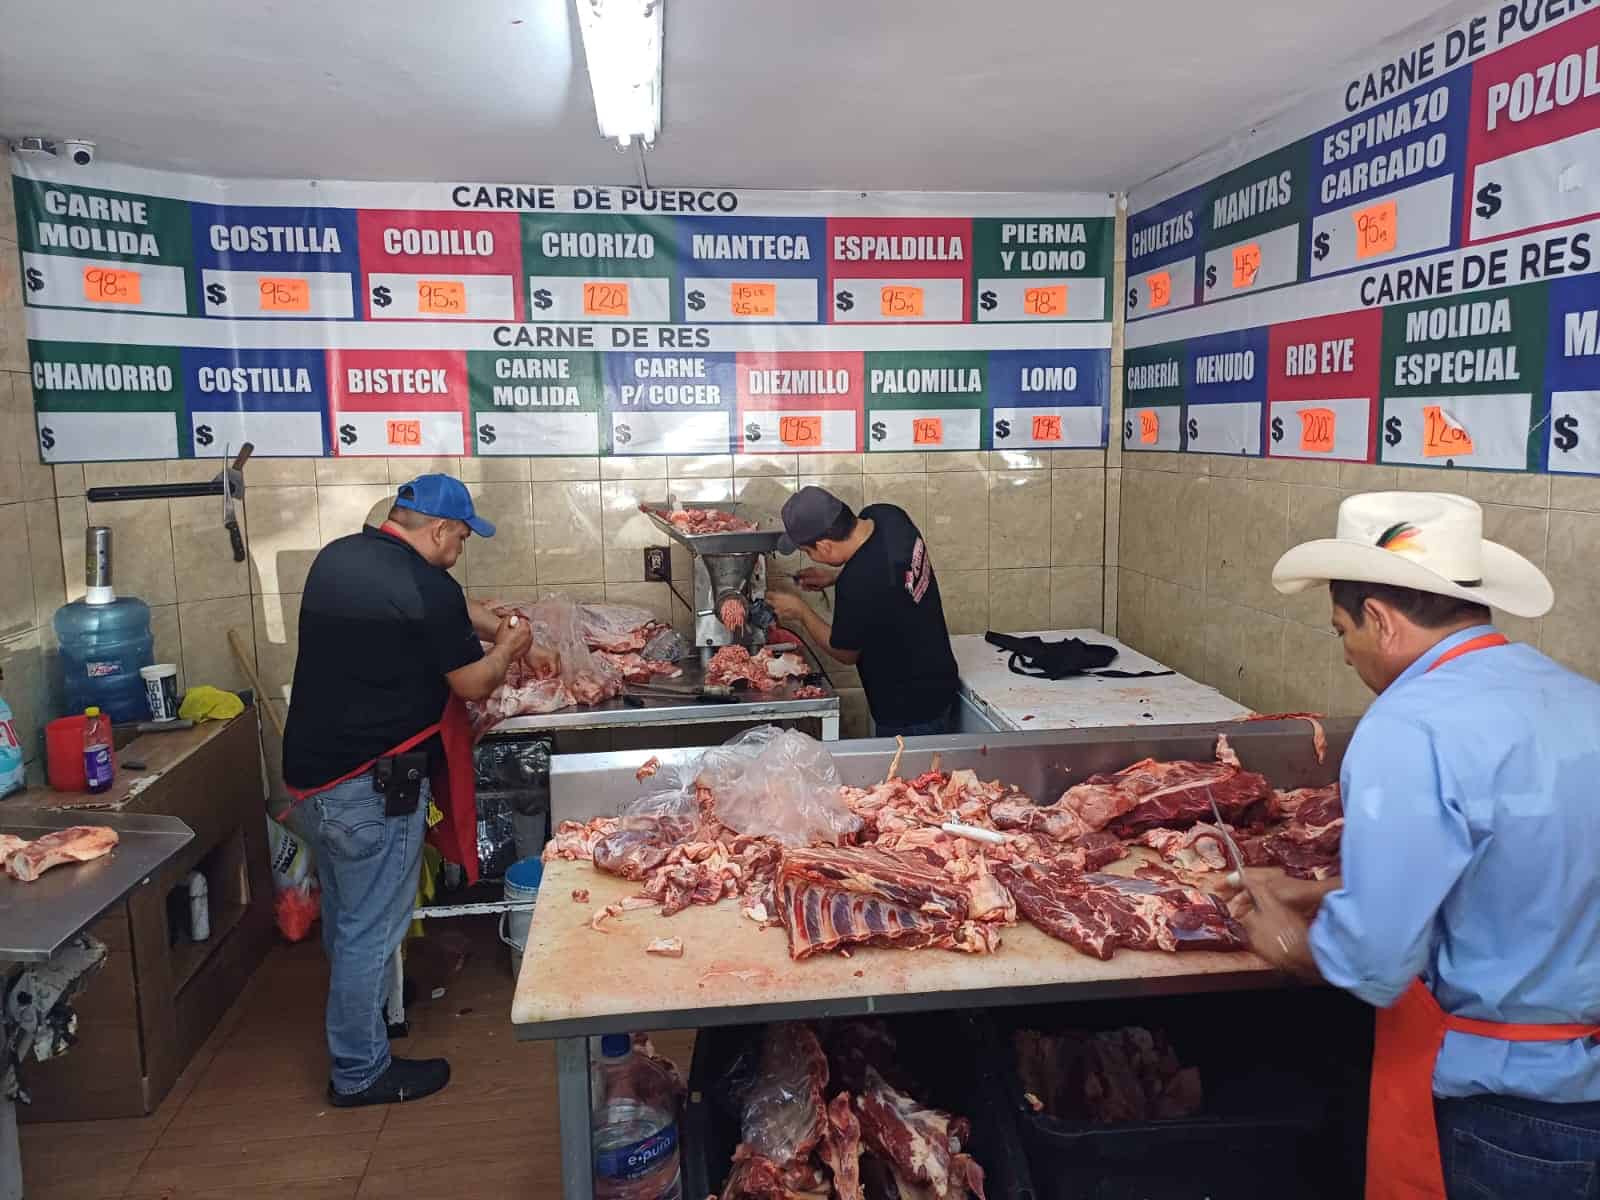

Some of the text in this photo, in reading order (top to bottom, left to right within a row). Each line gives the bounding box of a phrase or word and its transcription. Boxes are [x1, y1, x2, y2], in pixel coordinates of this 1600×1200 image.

[1345, 0, 1592, 112] CARNE DE PUE
[1322, 86, 1449, 166] ESPINAZO
[1320, 133, 1447, 204] CARGADO
[45, 190, 148, 225] CARNE
[452, 186, 738, 212] CARNE DE PUERCO
[1213, 170, 1292, 231] MANITAS
[1475, 182, 1502, 220] $
[38, 222, 160, 257] MOLIDA
[209, 225, 341, 253] COSTILLA
[383, 228, 494, 256] CODILLO
[542, 232, 655, 259] CHORIZO
[1002, 223, 1087, 244] PIERNA
[1131, 210, 1194, 258] CHULETAS
[1313, 232, 1331, 261] $
[692, 234, 810, 260] MANTECA
[834, 235, 964, 261] ESPALDILLA
[1001, 251, 1086, 271] Y LOMO
[1361, 232, 1591, 307] CARNE DE RES
[26, 267, 44, 292] $
[1205, 266, 1218, 288] $
[206, 283, 227, 306] $
[372, 285, 393, 308] $
[533, 288, 553, 310] $
[687, 290, 707, 311] $
[836, 290, 854, 312] $
[980, 290, 998, 311] $
[1406, 298, 1512, 344] MOLIDA
[1564, 310, 1600, 357] M
[493, 326, 710, 347] CARNE DE RES
[495, 358, 569, 379] CARNE
[634, 357, 705, 379] CARNE
[1196, 350, 1254, 384] MENUDO
[1286, 338, 1354, 377] RIB EYE
[1394, 346, 1521, 387] ESPECIAL
[33, 361, 173, 392] CHAMORRO
[198, 366, 312, 393] COSTILLA
[347, 368, 448, 394] BISTECK
[749, 369, 849, 394] DIEZMILLO
[871, 368, 982, 393] PALOMILLA
[1021, 367, 1078, 392] LOMO
[1127, 358, 1179, 390] CABRERÍA
[493, 386, 581, 406] MOLIDA
[620, 385, 721, 406] P/ COCER
[41, 426, 55, 449] $
[196, 424, 214, 446] $
[340, 423, 418, 445] $ 195
[479, 424, 497, 445] $
[871, 422, 887, 442] $
[995, 419, 1011, 439] $
[1271, 416, 1285, 441] $
[1385, 416, 1403, 446] $
[1553, 413, 1579, 453] $
